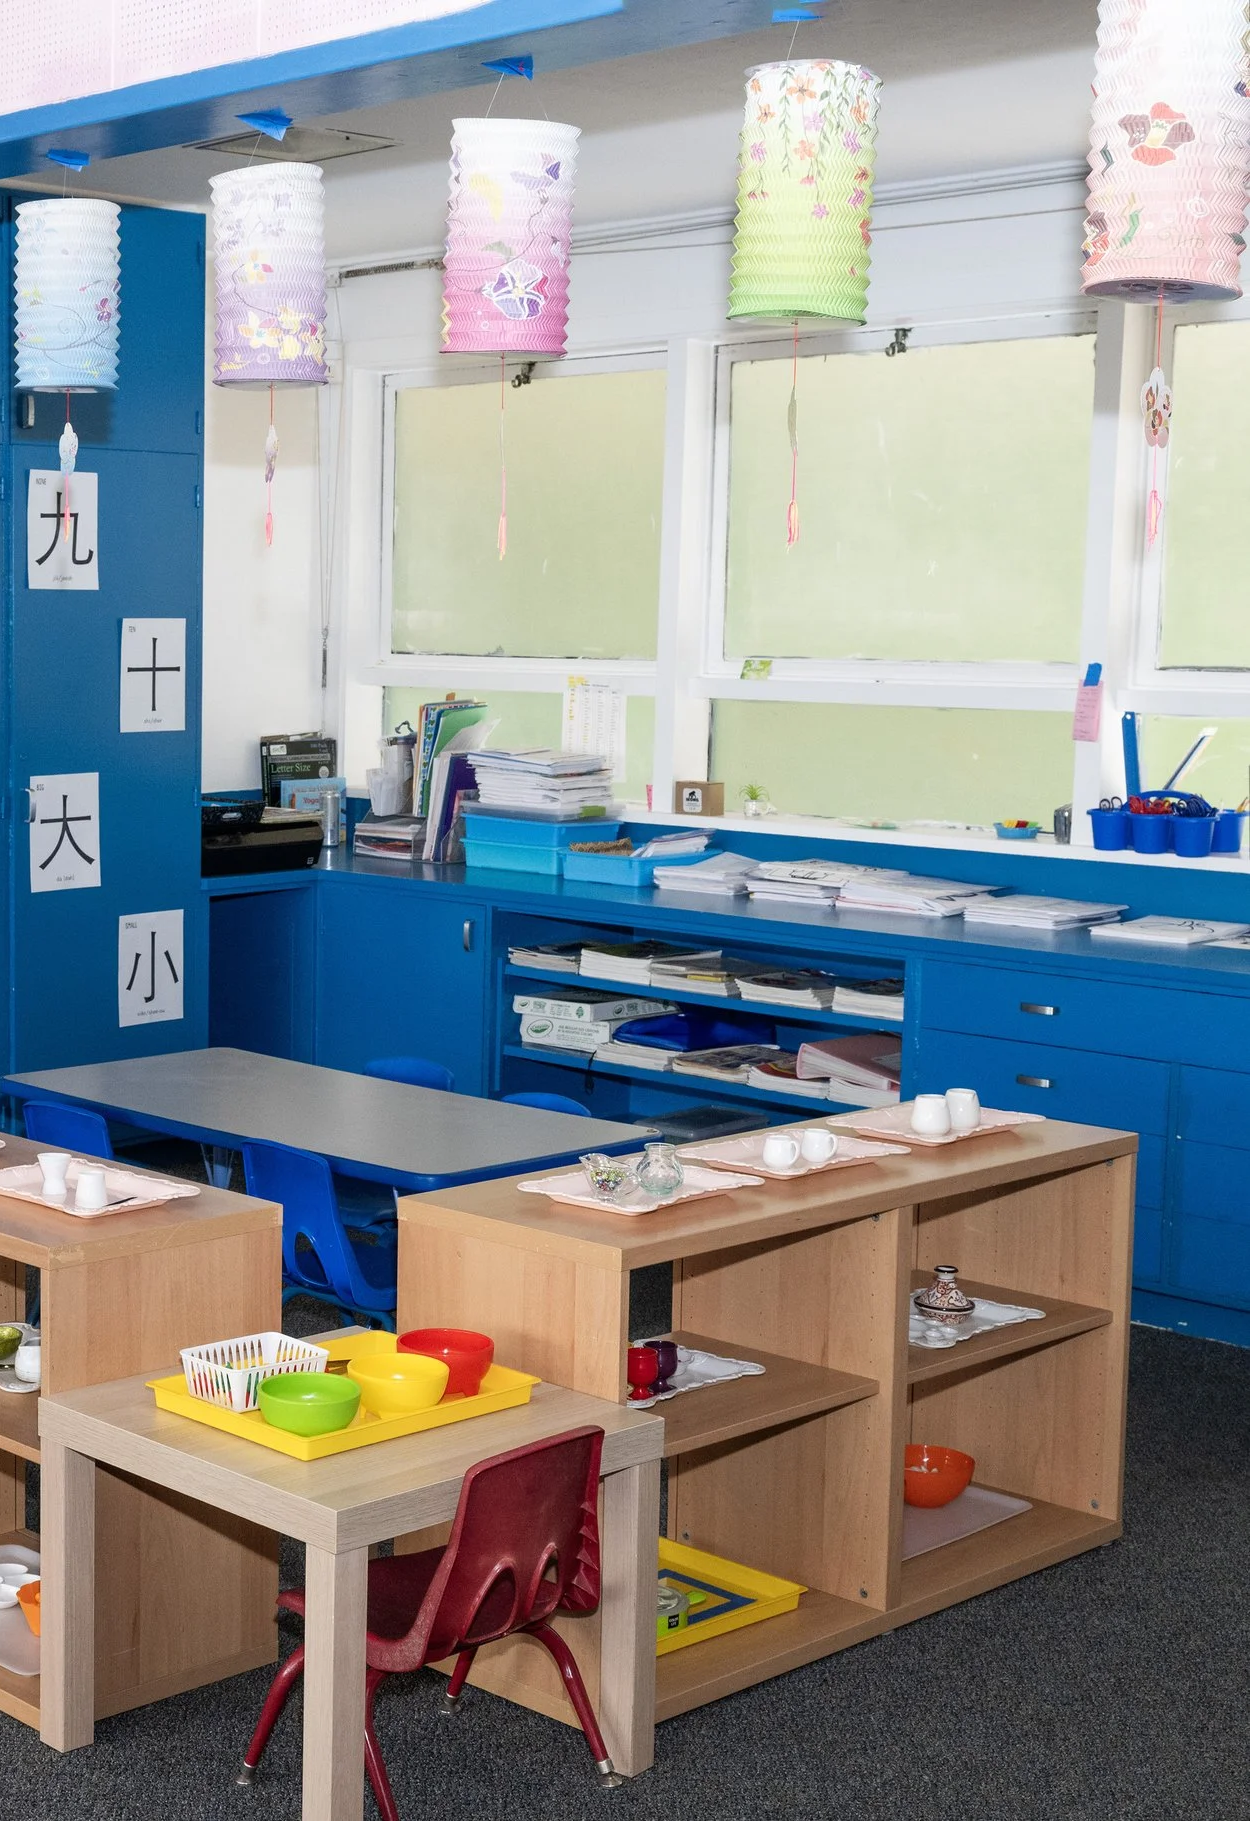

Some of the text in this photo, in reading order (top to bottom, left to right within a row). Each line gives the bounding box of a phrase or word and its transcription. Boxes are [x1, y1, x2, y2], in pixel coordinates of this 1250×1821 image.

[35, 491, 94, 566] 九
[126, 637, 181, 712] 十
[271, 762, 311, 774] Letter Size
[38, 794, 96, 871] 大
[126, 931, 180, 1004] 小
